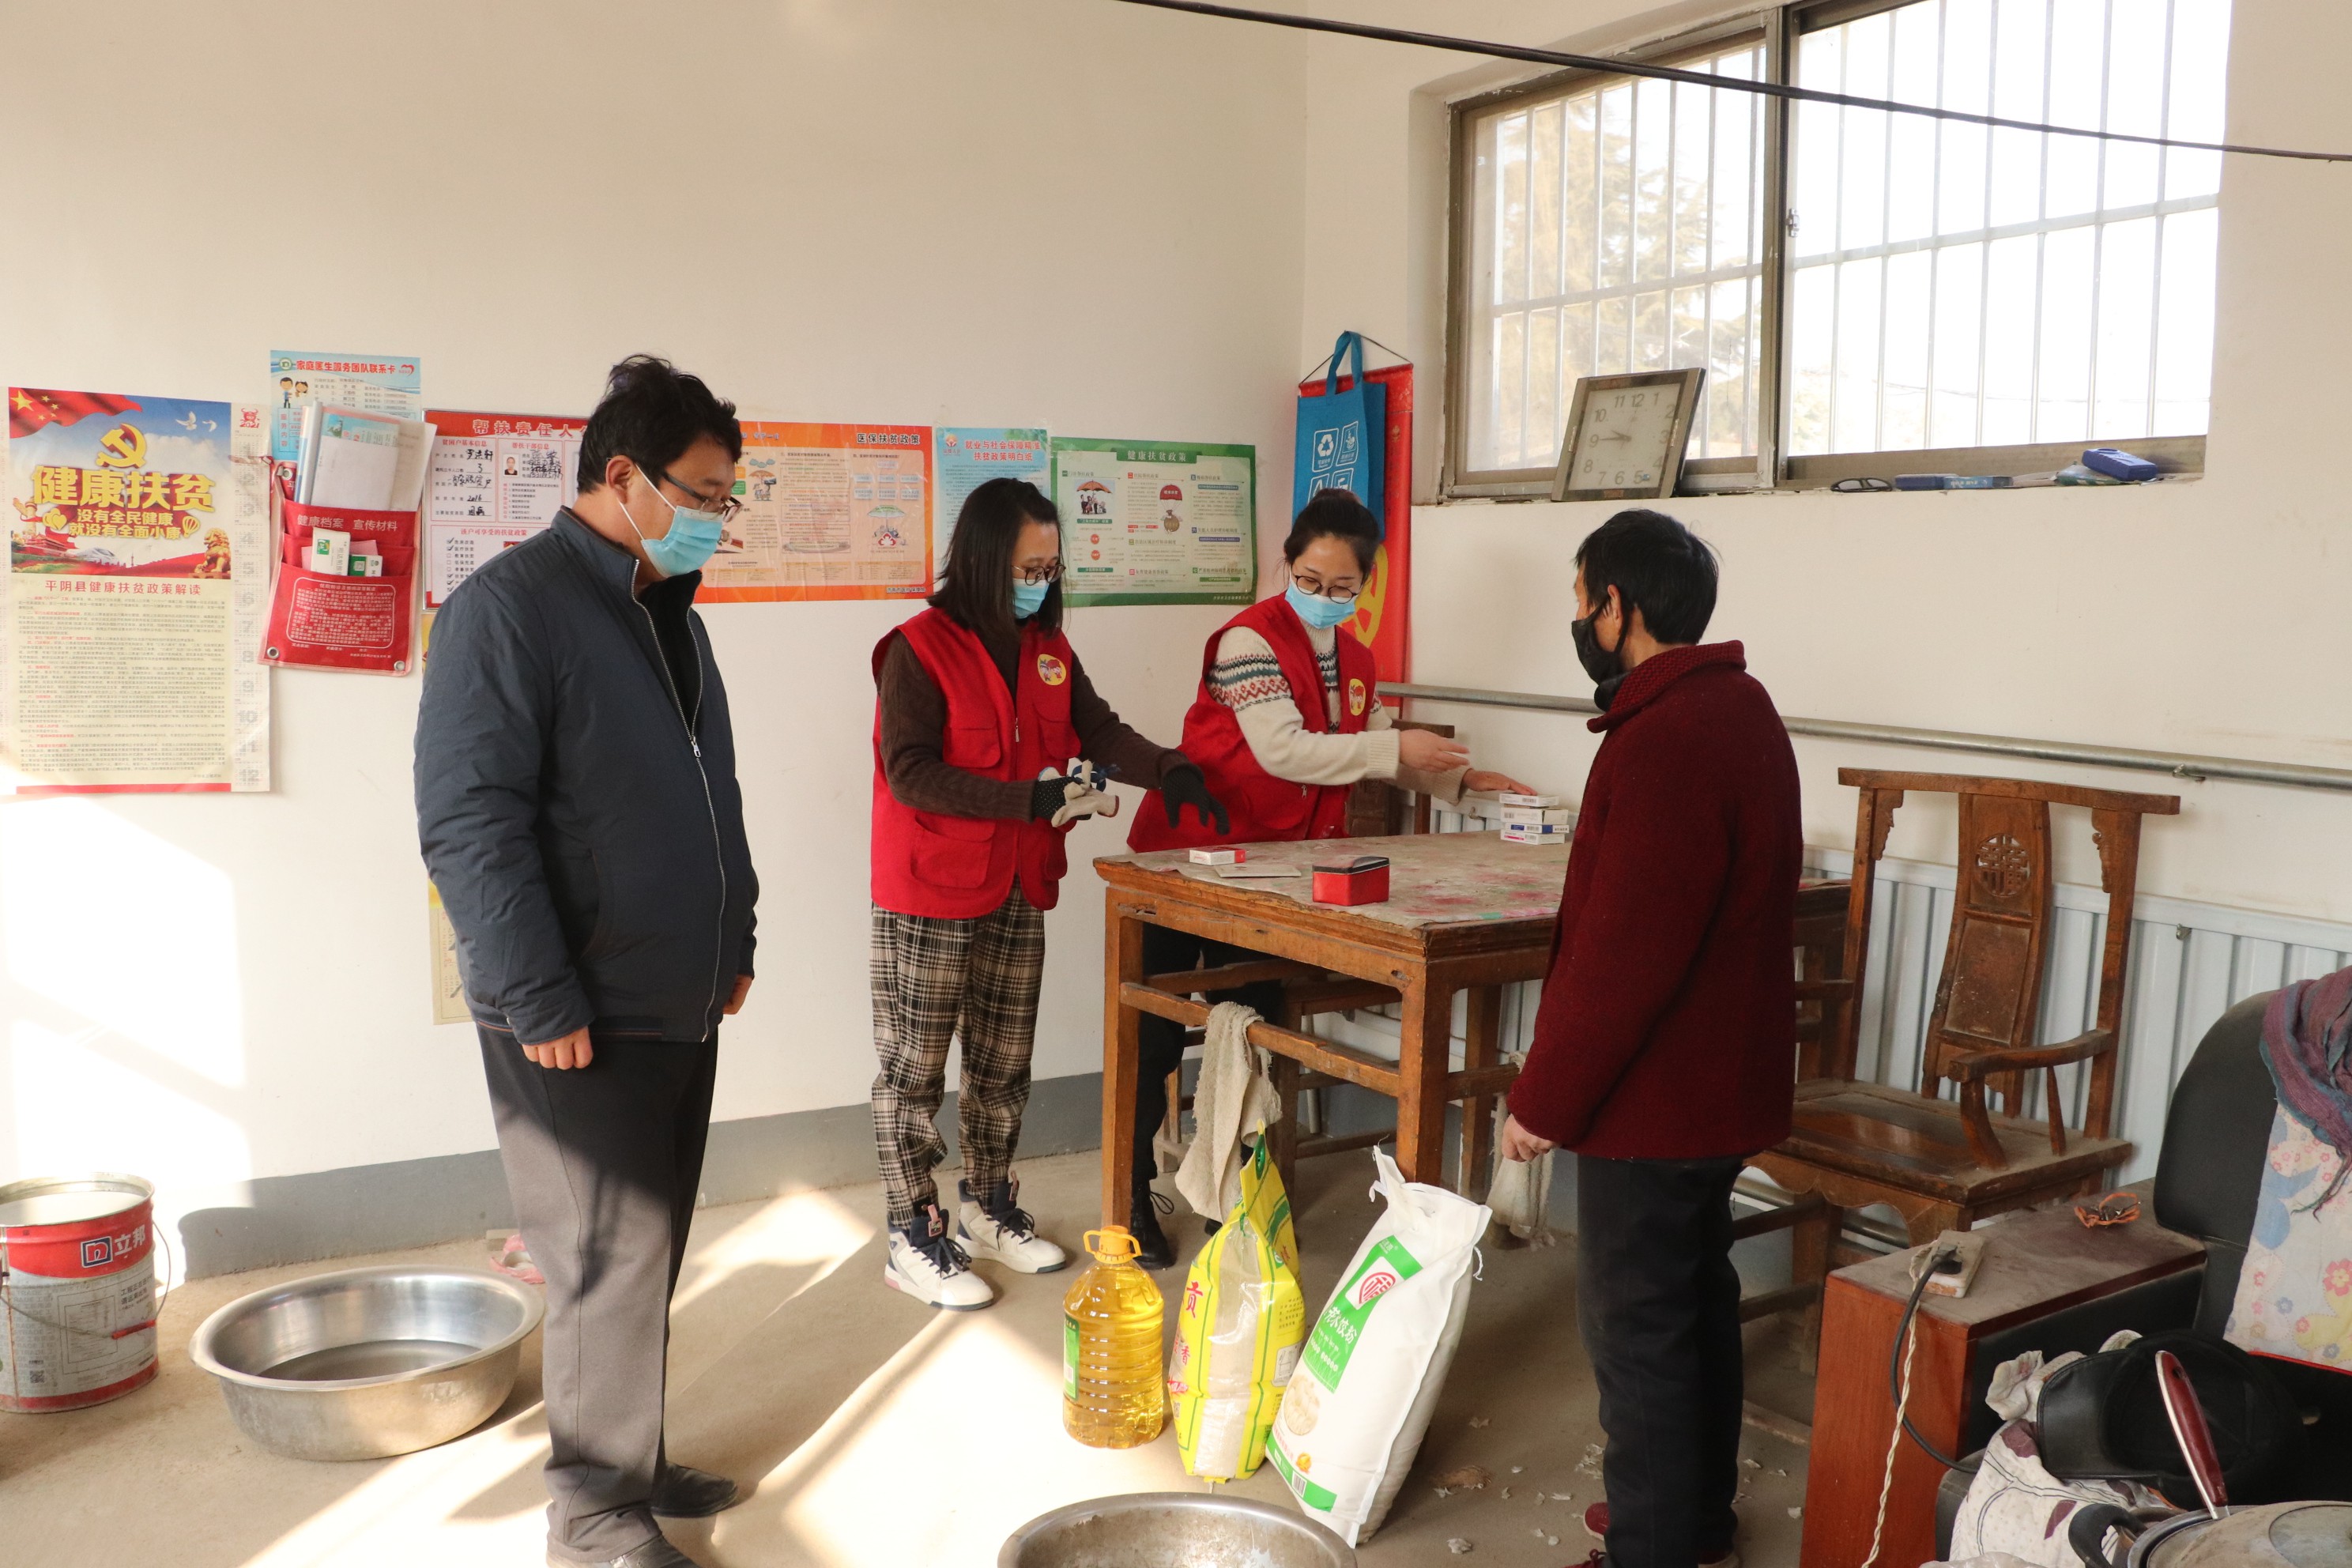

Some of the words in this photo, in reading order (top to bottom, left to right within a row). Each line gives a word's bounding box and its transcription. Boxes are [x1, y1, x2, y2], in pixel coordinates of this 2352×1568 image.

[296, 360, 396, 374] 家庭医生服务团队联系卡
[1614, 395, 1625, 408] 11
[1631, 394, 1645, 408] 12
[1653, 393, 1660, 406] 1
[1595, 409, 1607, 423] 10
[1665, 404, 1675, 419] 2
[857, 433, 920, 444] 医保扶贫政策
[965, 440, 1041, 450] 就业与社会保障精准
[1589, 434, 1600, 448] 9
[973, 452, 1033, 461] 扶贫政策明白纸
[1127, 450, 1186, 462] 健康扶贫政策
[1583, 459, 1593, 473] 8
[1614, 470, 1624, 485] 6
[32, 465, 216, 513] 健康扶贫
[77, 508, 174, 526] 没有全民健康
[297, 514, 345, 530] 健康档案
[352, 518, 398, 533] 宣传材料
[69, 522, 182, 541] 就没有全面小康
[45, 579, 202, 596] 平阴县健康扶贫政策解读
[115, 1224, 145, 1256] 立邦
